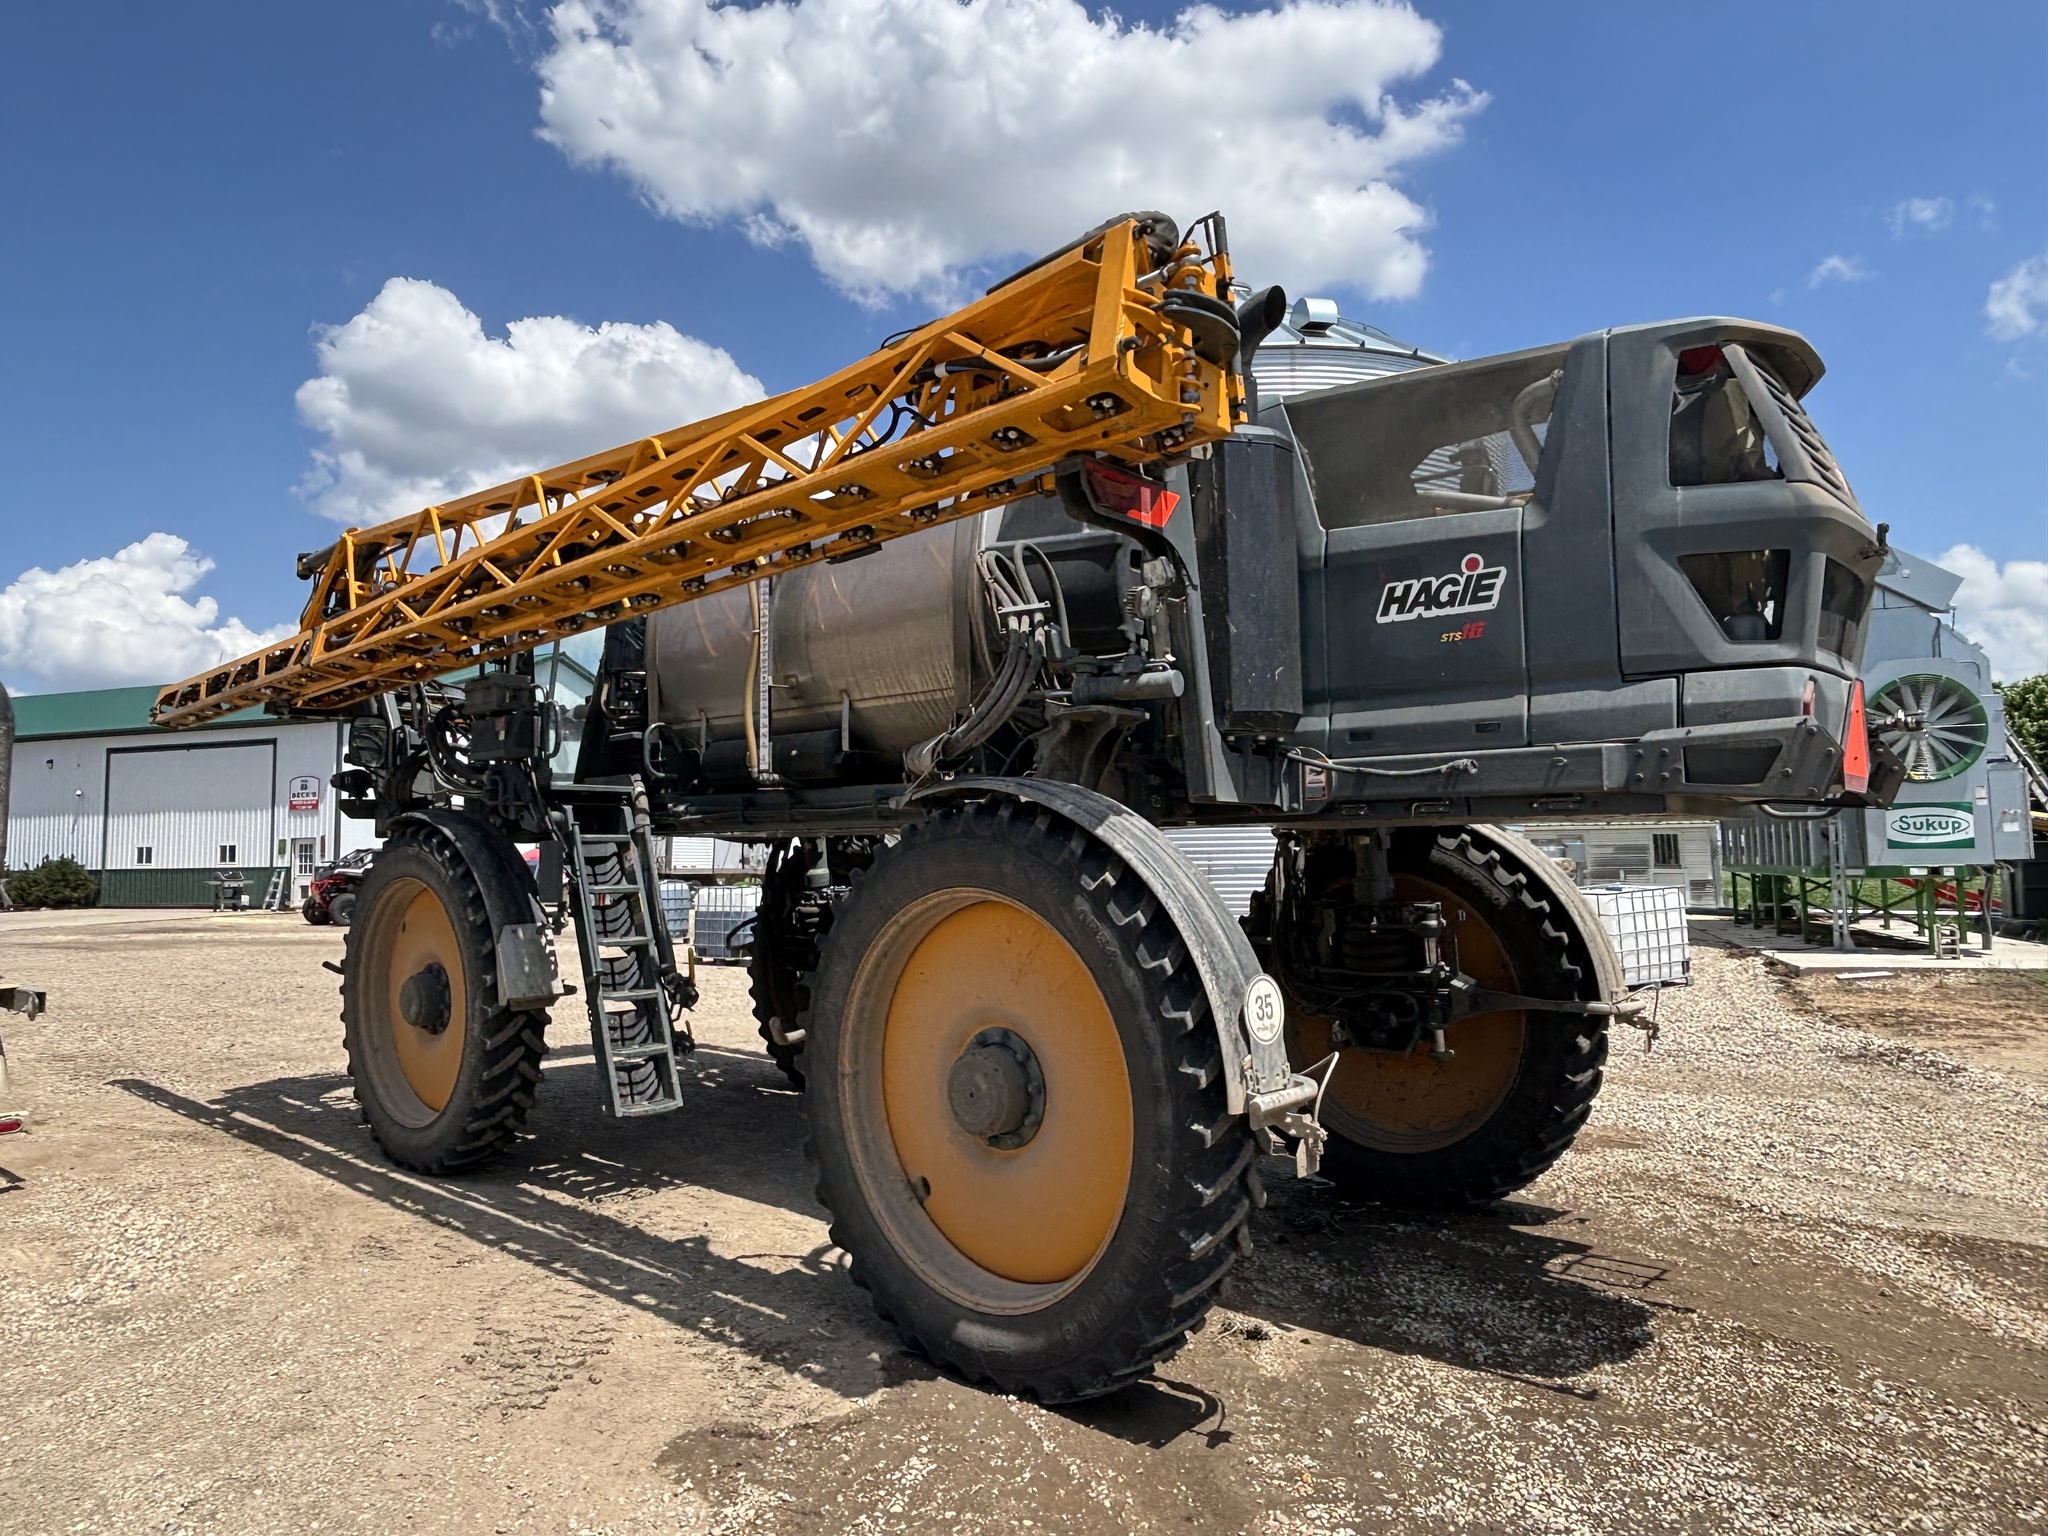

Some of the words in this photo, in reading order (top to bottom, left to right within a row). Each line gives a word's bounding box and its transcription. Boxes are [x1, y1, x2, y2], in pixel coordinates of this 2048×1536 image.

[1379, 556, 1503, 618] HAGIE
[1898, 815, 1962, 835] Sukup
[1255, 993, 1274, 1021] 35
